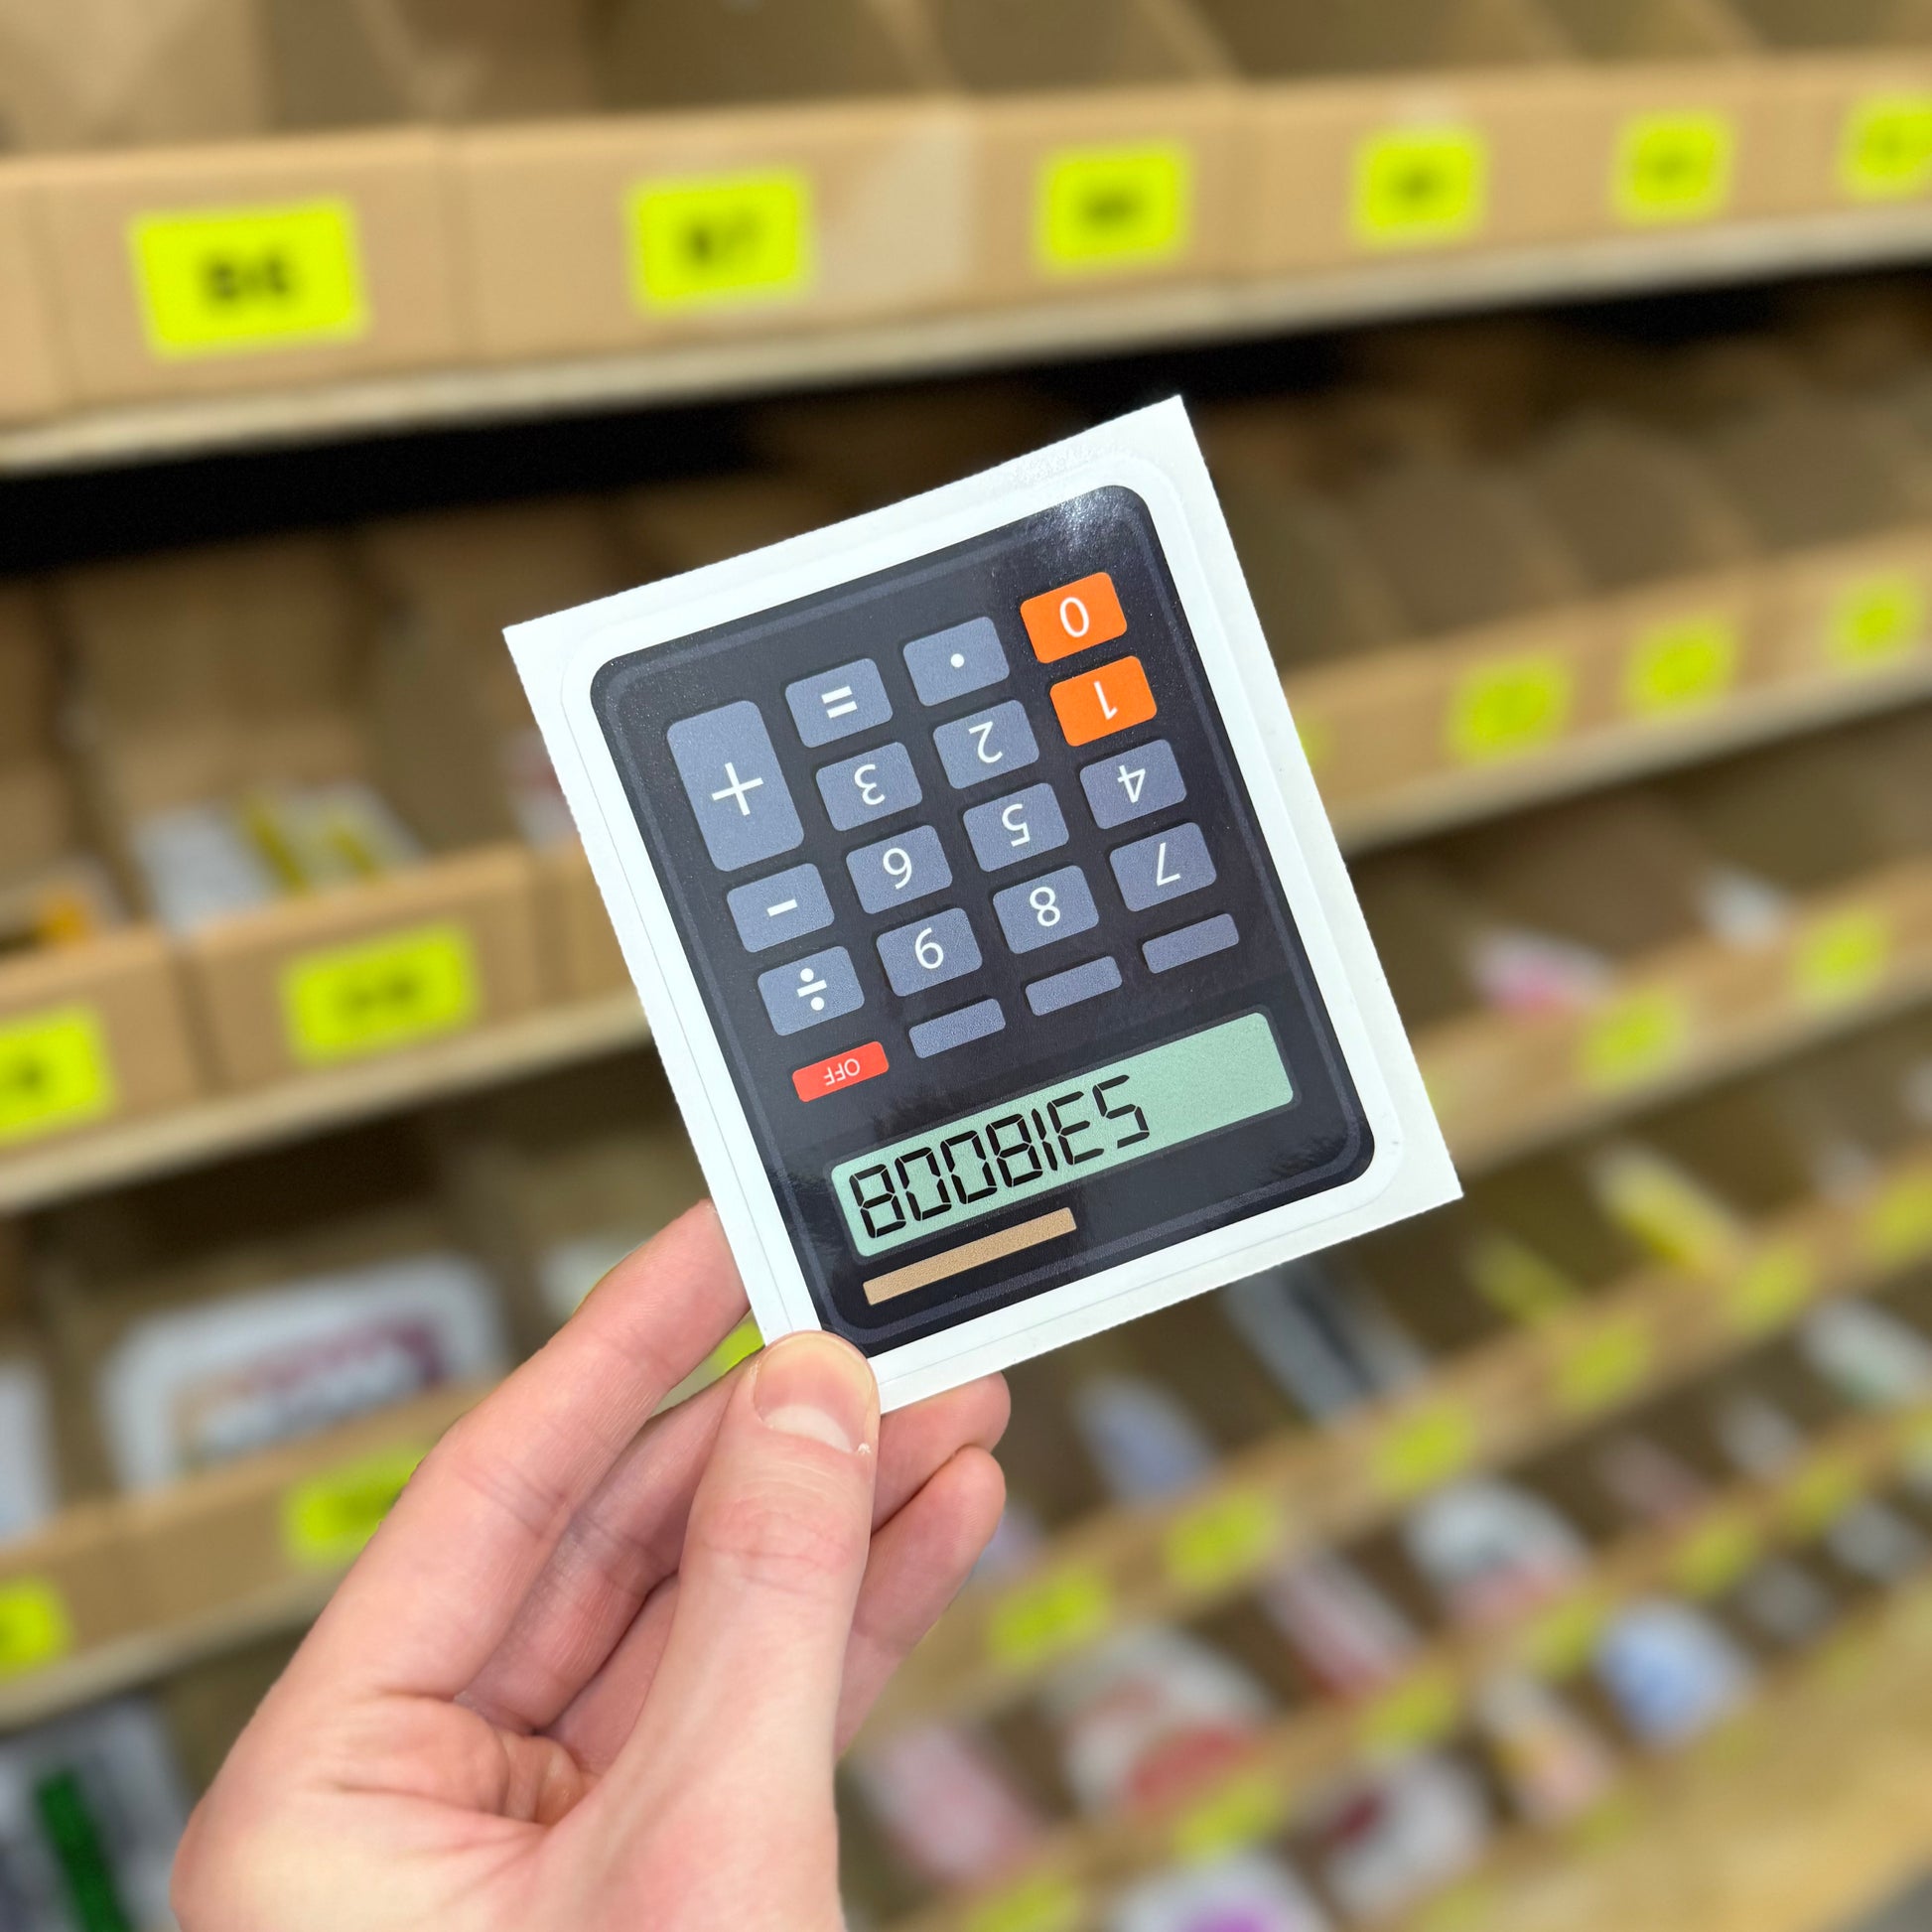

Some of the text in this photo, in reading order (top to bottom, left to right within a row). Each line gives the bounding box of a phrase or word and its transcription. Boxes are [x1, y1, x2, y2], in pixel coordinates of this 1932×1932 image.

[1059, 597, 1090, 637] 0
[1093, 680, 1118, 720] 1
[968, 721, 1003, 763] 2
[854, 763, 886, 806] 3
[1117, 764, 1146, 803] 4
[1001, 803, 1031, 847] 5
[1156, 842, 1181, 887] 7
[1029, 886, 1061, 927] 8
[822, 1057, 862, 1087] OFF
